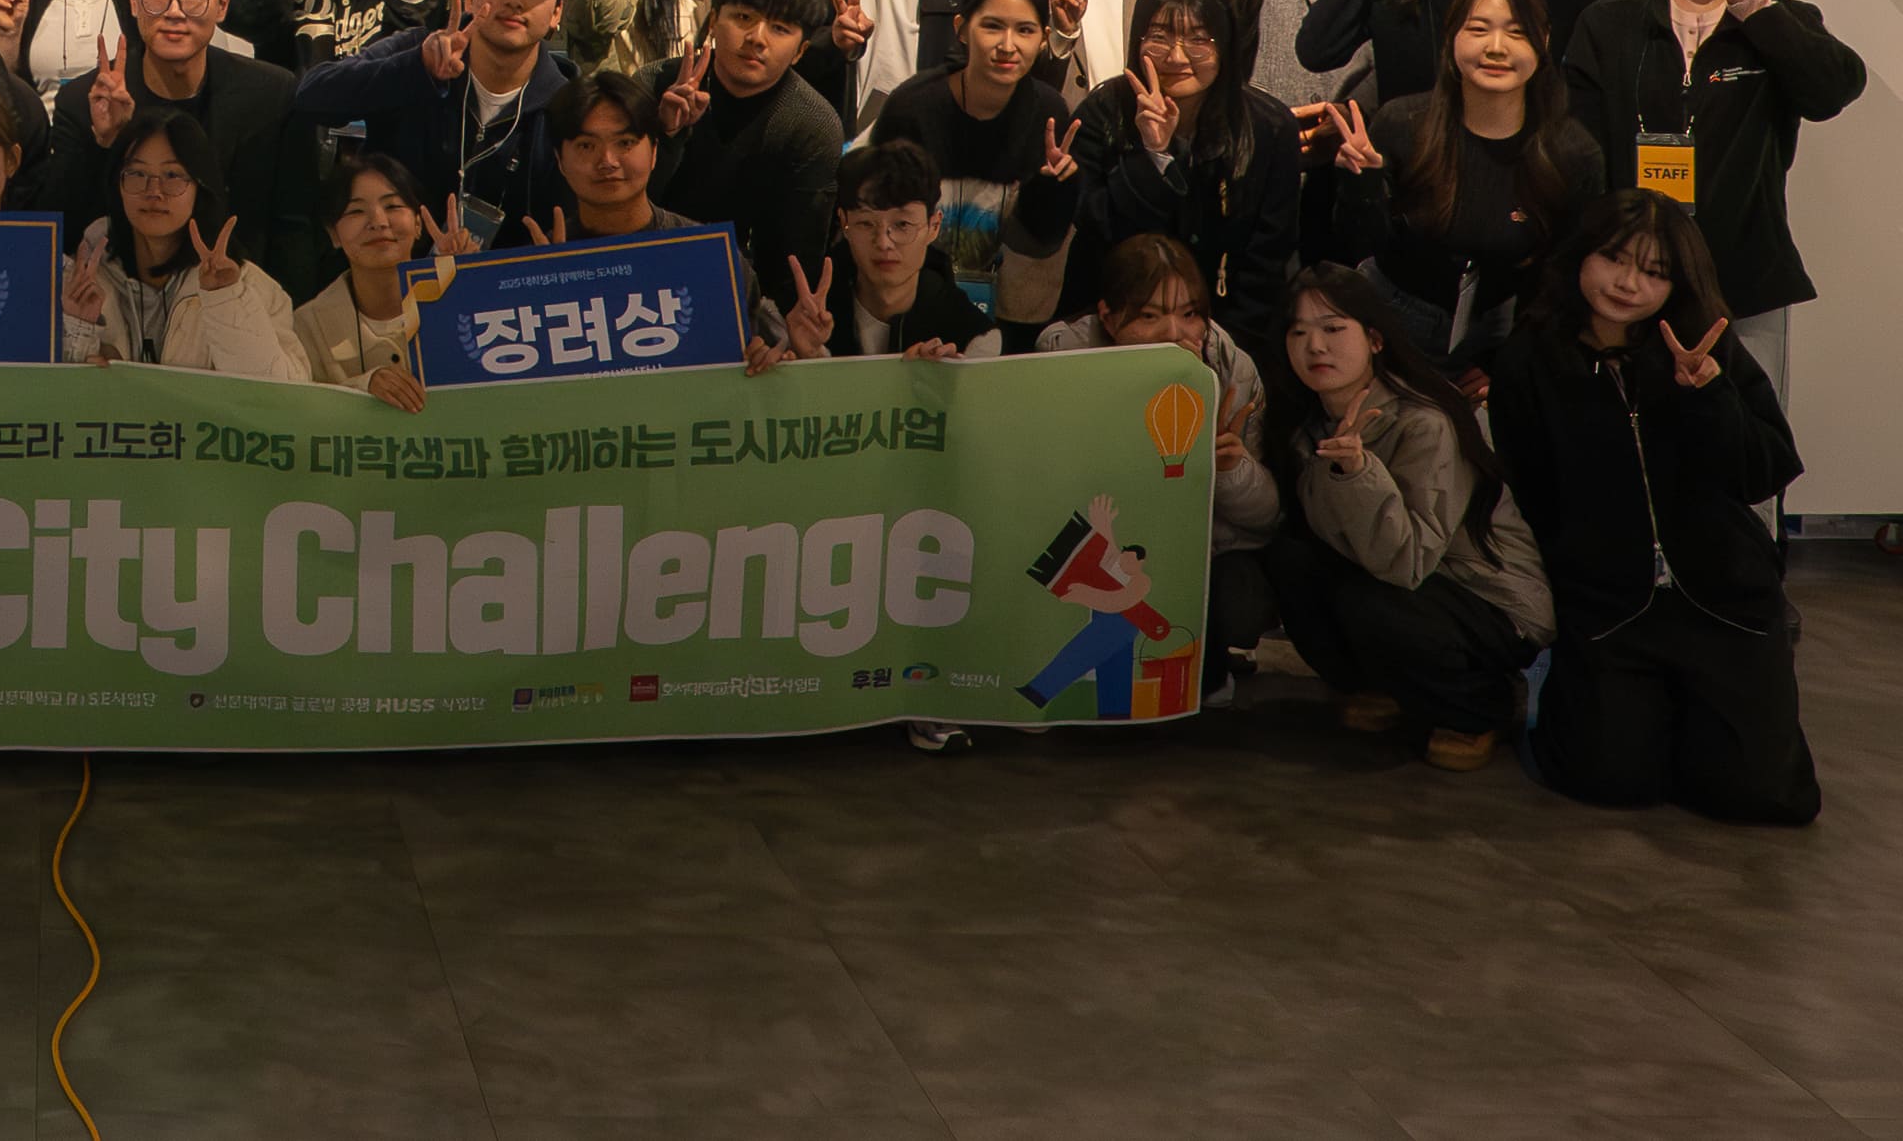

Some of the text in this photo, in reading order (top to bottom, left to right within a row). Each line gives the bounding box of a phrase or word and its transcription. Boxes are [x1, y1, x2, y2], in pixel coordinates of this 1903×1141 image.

[1643, 168, 1689, 180] STAFF
[474, 289, 681, 374] 장려상
[73, 420, 187, 460] 고도화
[196, 421, 295, 472] 2025
[310, 435, 491, 480] 대학생과
[500, 424, 677, 478] 함께하는
[690, 407, 947, 466] 도시재생사업
[261, 501, 977, 658] Challenge
[852, 667, 892, 690] 후원
